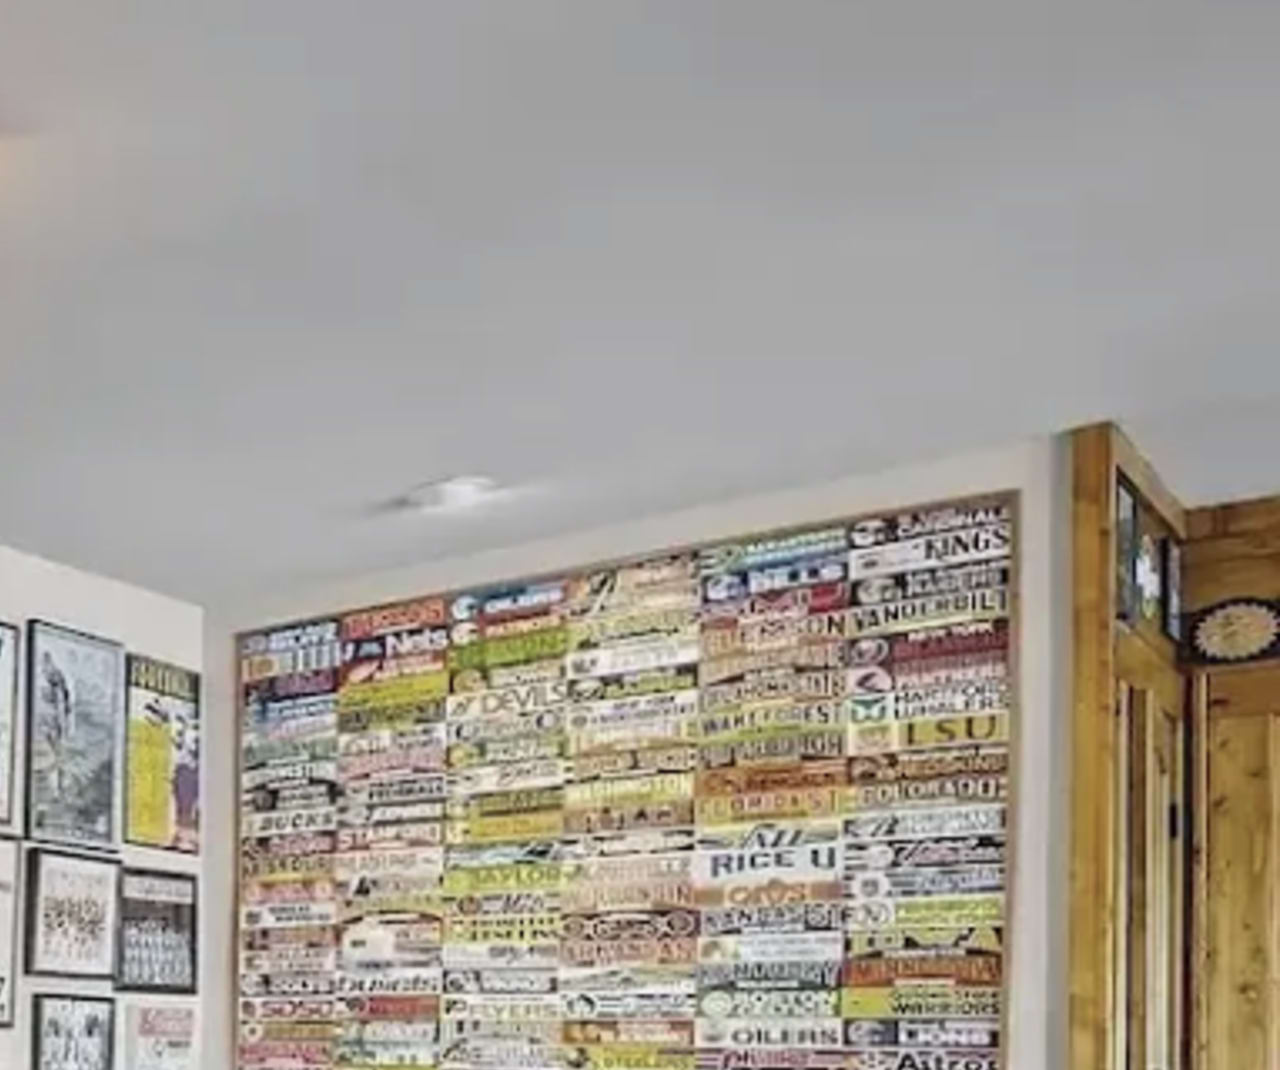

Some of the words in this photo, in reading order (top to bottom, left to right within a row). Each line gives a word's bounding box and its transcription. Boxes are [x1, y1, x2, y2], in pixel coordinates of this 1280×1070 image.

[924, 526, 1010, 559] KINGS
[852, 590, 1011, 632] VANDERBILT
[385, 628, 450, 655] Nets
[483, 683, 565, 712] DEVILS
[258, 812, 334, 832] BUCKS
[710, 849, 795, 877] RICE
[810, 846, 837, 869] U
[731, 1027, 839, 1045] OILERS
